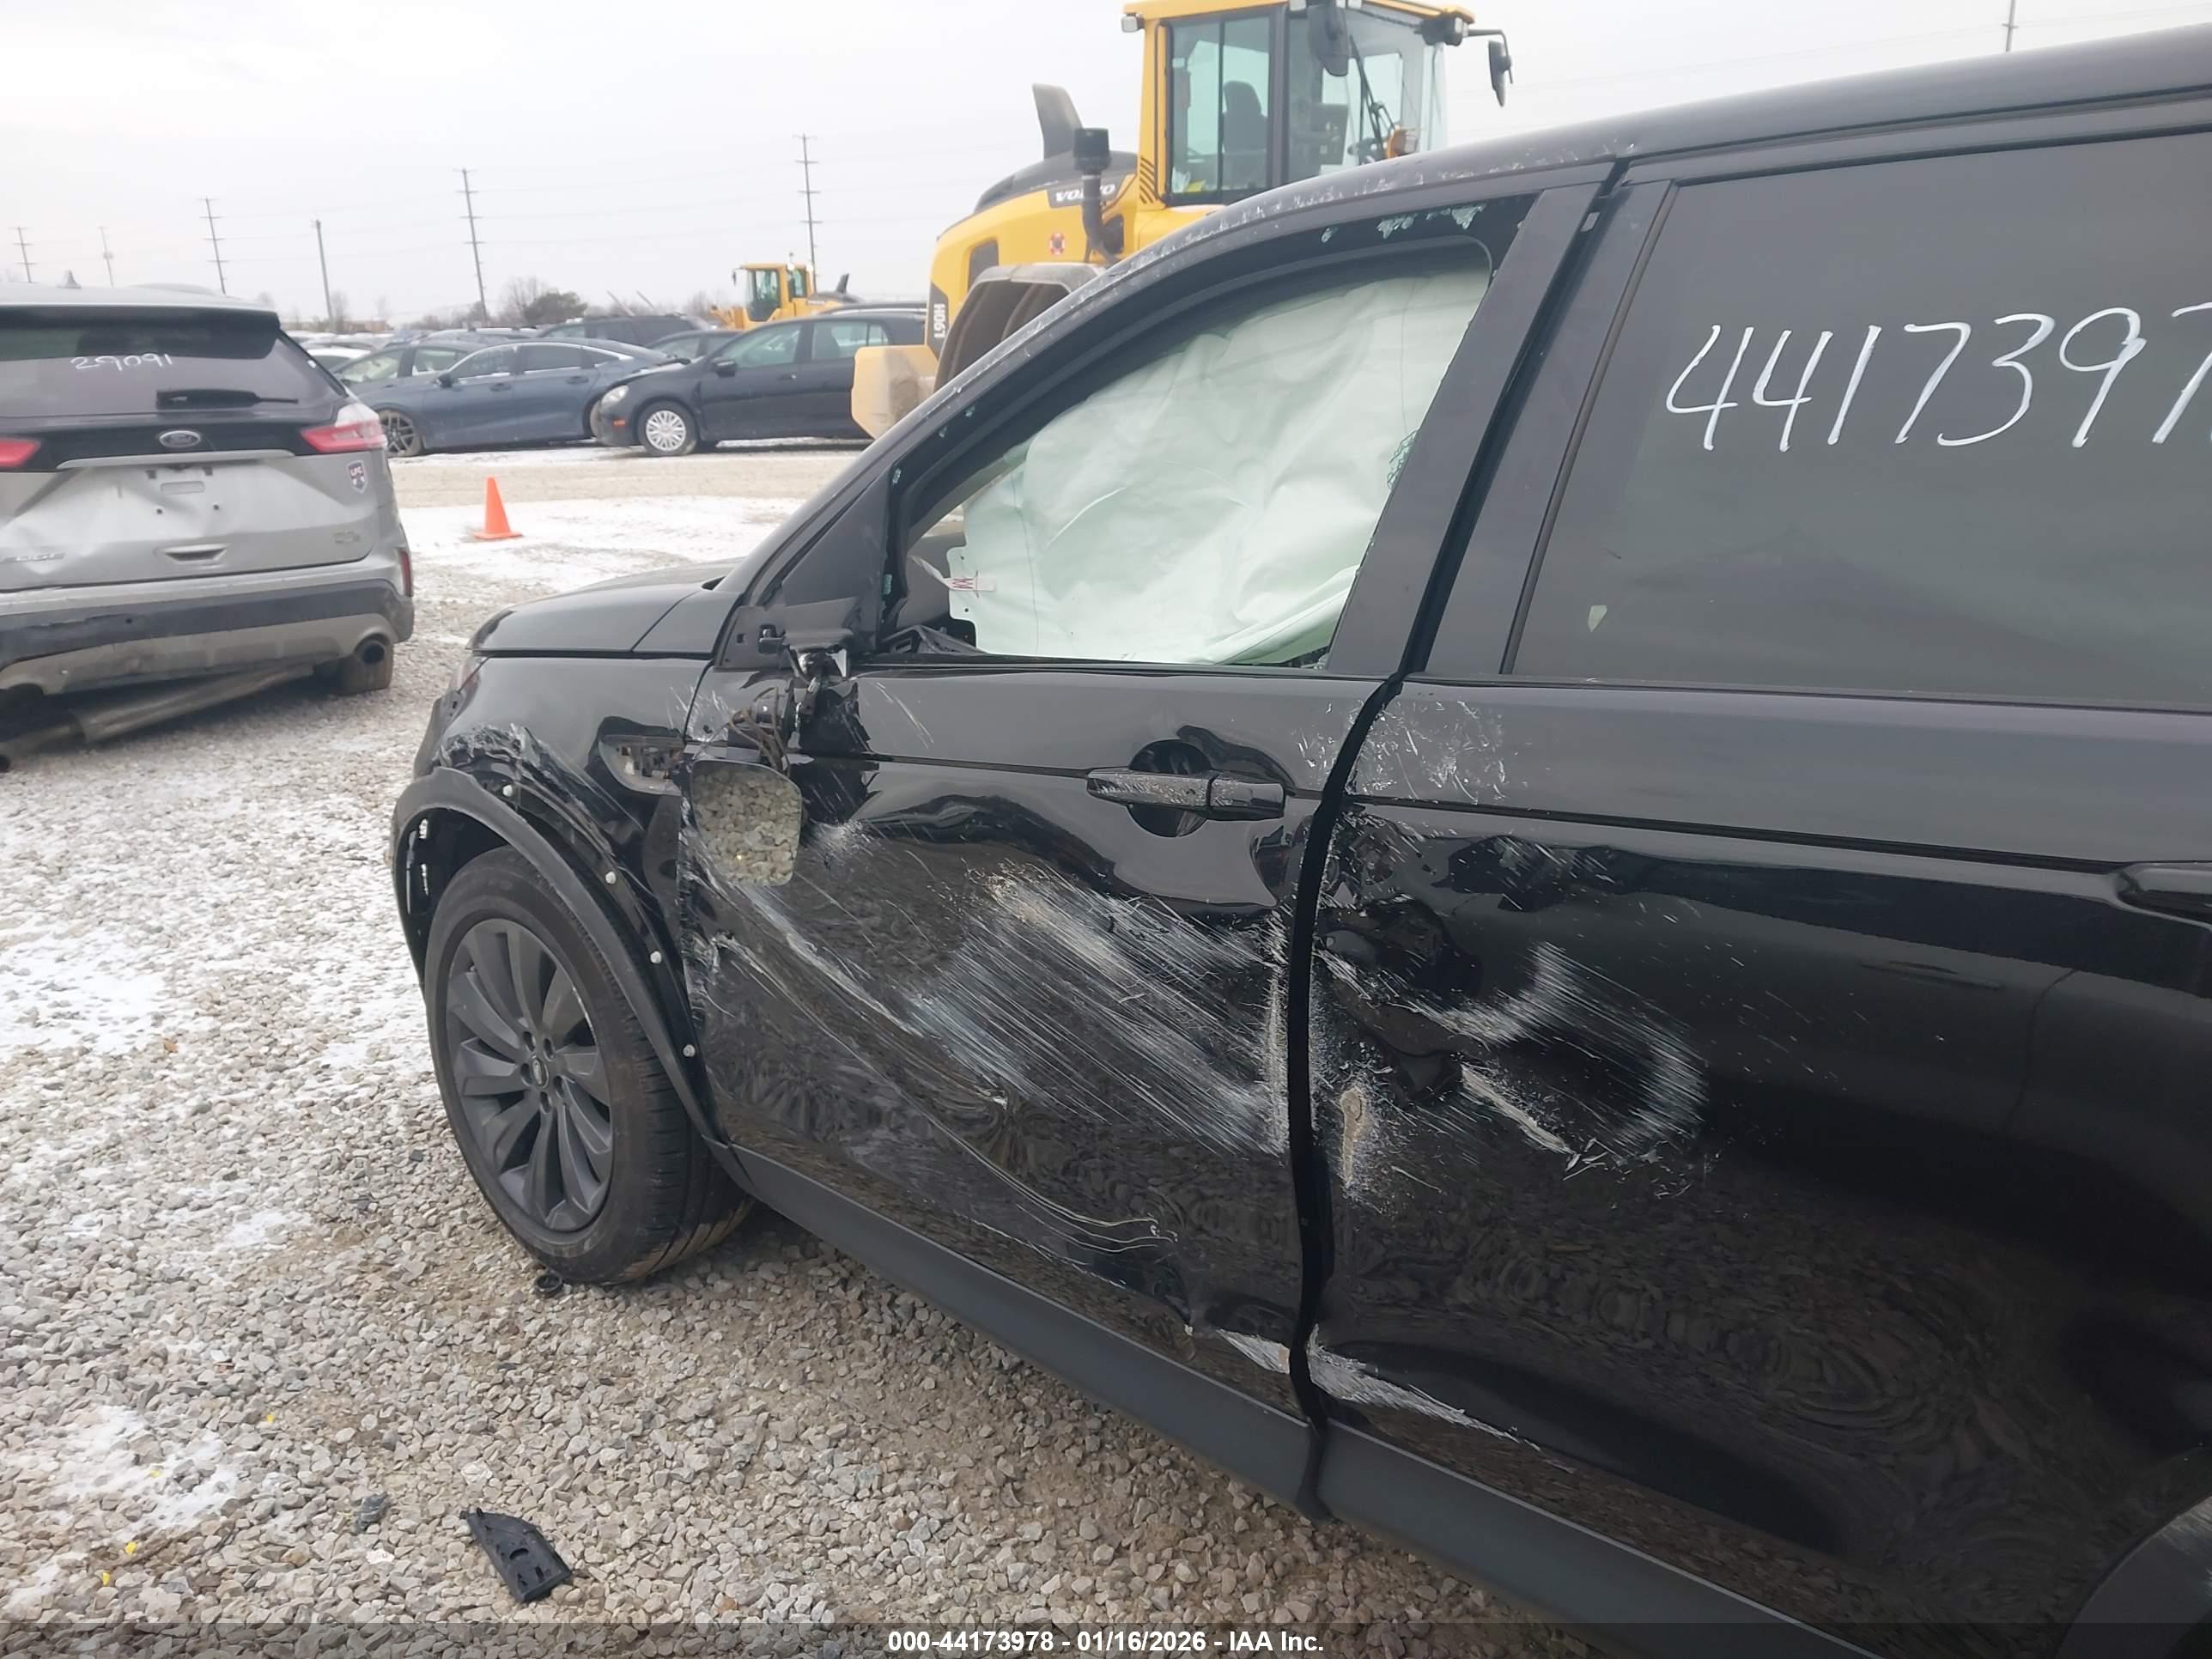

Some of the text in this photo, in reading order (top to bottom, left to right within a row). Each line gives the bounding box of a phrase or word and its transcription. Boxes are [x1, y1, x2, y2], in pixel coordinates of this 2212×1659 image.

[1055, 184, 1116, 202] VOLO
[933, 303, 946, 338] L90H
[70, 353, 173, 371] 29091
